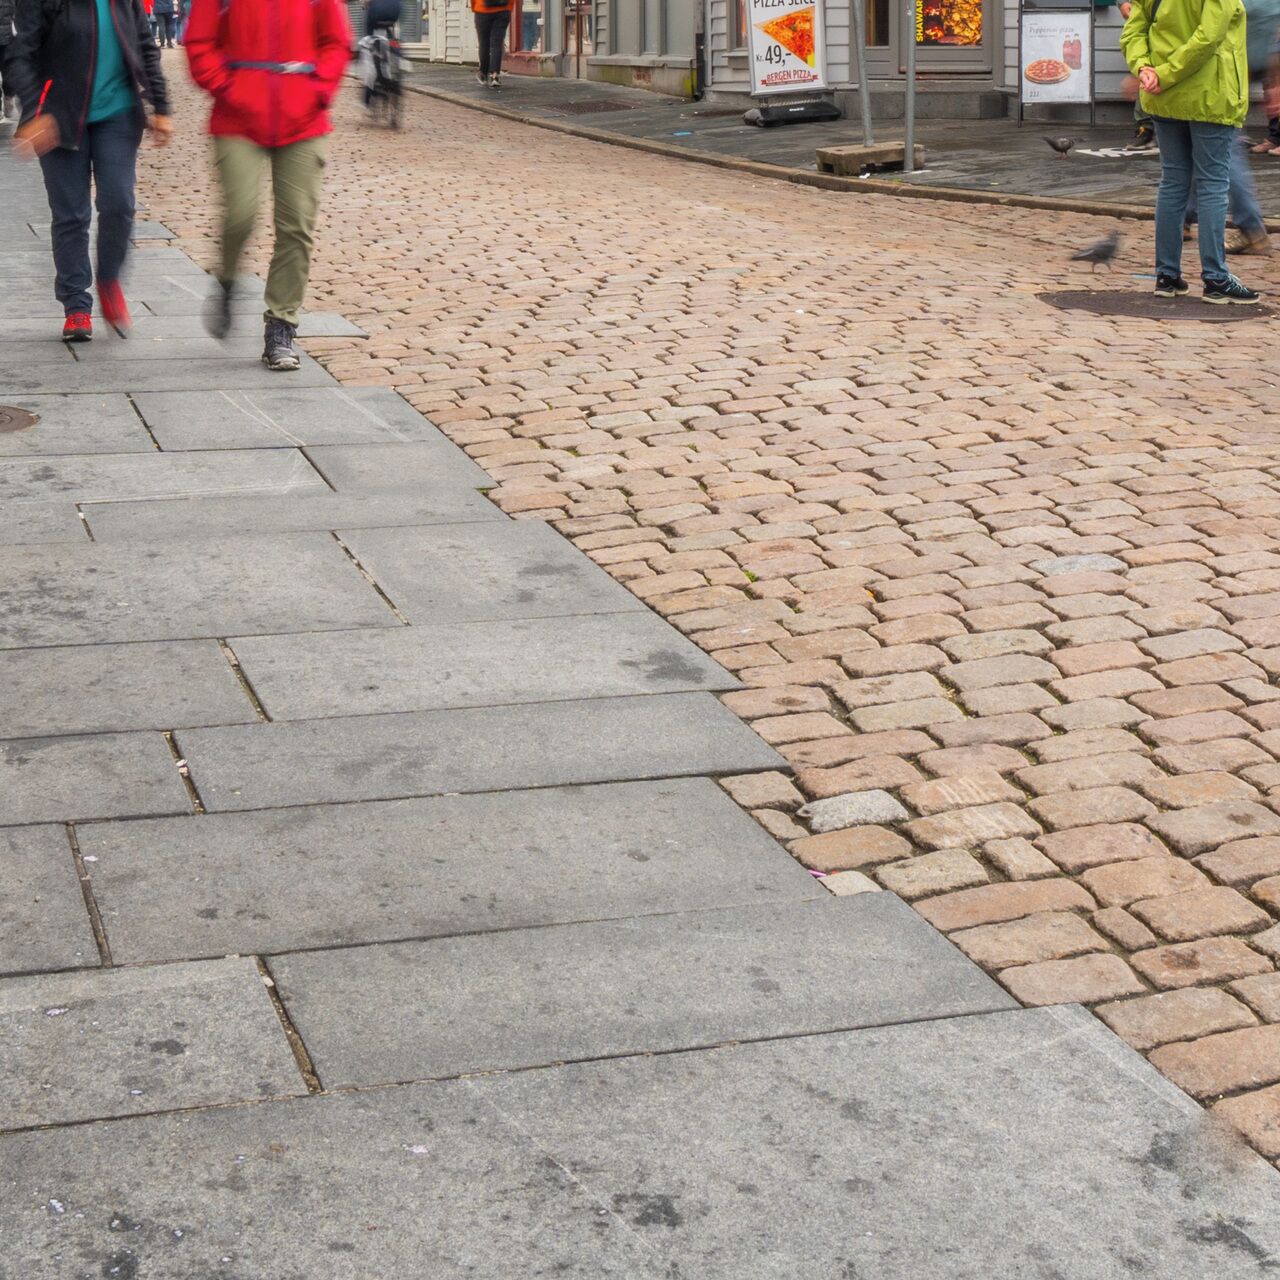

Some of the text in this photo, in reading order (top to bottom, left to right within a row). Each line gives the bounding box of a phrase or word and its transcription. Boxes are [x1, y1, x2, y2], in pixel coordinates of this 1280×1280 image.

[765, 44, 792, 67] 49,-
[766, 69, 812, 82] BERGEN PIZZA
